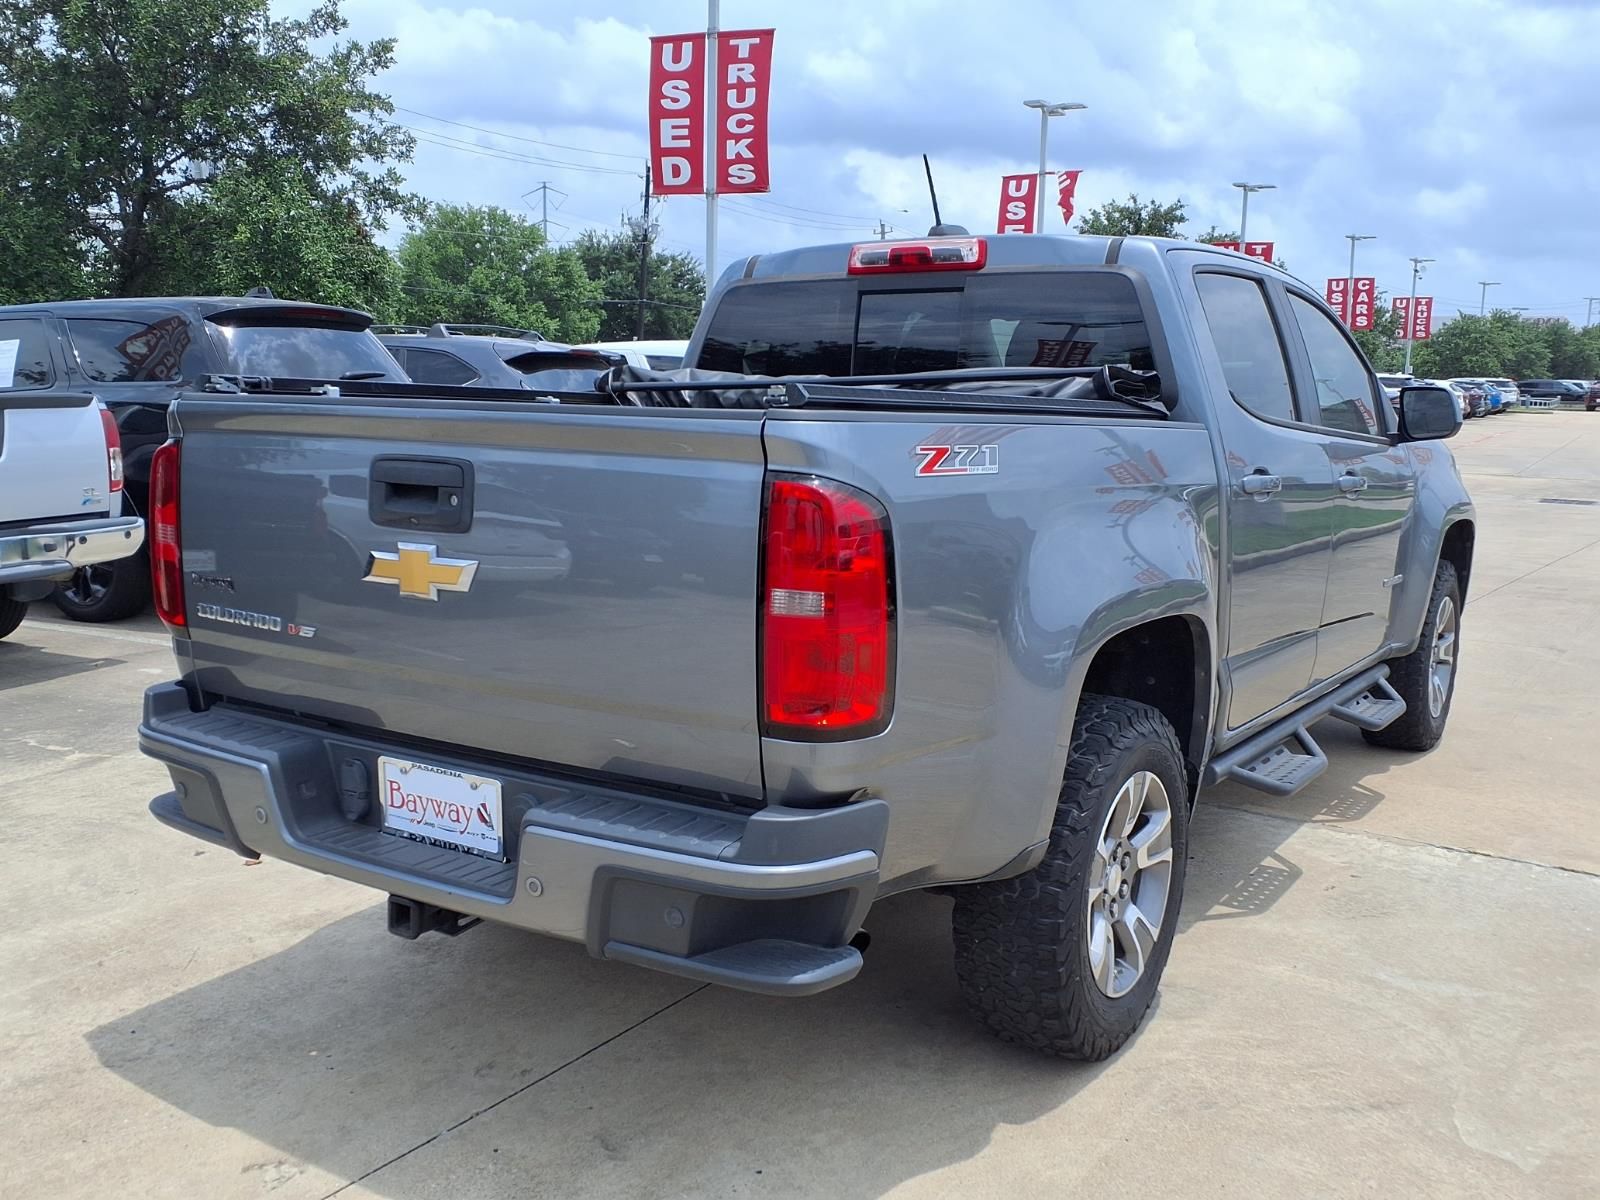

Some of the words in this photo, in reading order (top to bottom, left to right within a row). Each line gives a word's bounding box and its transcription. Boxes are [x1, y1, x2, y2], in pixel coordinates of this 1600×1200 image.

[660, 41, 693, 186] USED
[726, 37, 760, 185] TRUCKS
[1355, 279, 1370, 327] CARS
[1415, 298, 1429, 338] TRUCKS
[915, 444, 999, 477] Z71
[196, 602, 282, 632] COLORADO
[411, 763, 463, 779] PASADENA
[387, 779, 474, 835] Bayway
